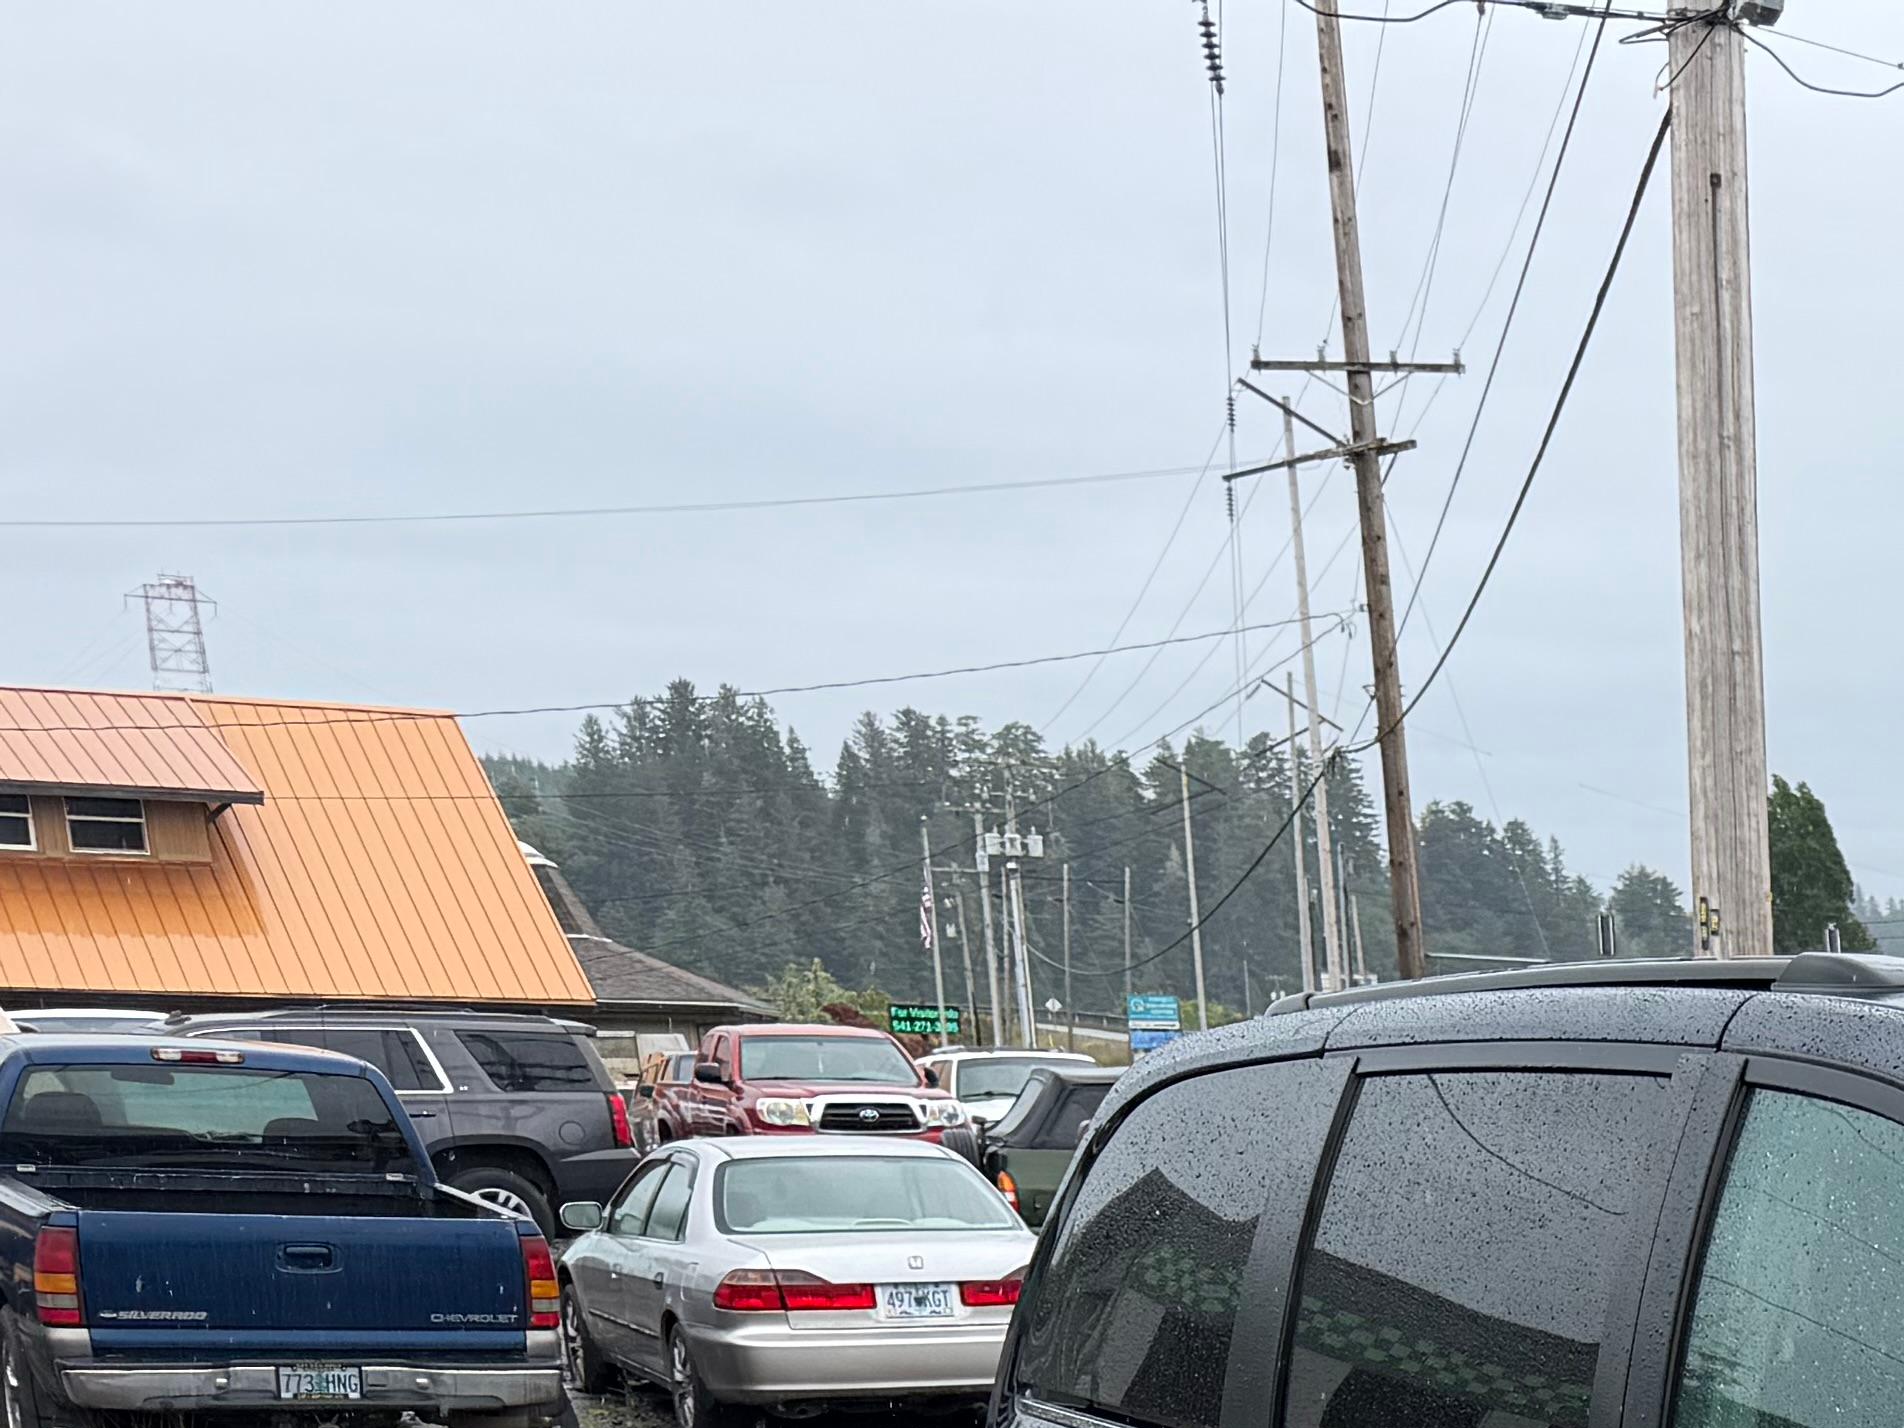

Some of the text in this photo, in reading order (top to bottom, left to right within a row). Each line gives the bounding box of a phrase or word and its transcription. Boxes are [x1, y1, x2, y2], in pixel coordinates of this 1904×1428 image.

[887, 1291, 913, 1308] 497
[118, 1310, 208, 1320] SILVERADO
[430, 1313, 518, 1323] CHEVROLET
[281, 1374, 359, 1393] 773 HNG
